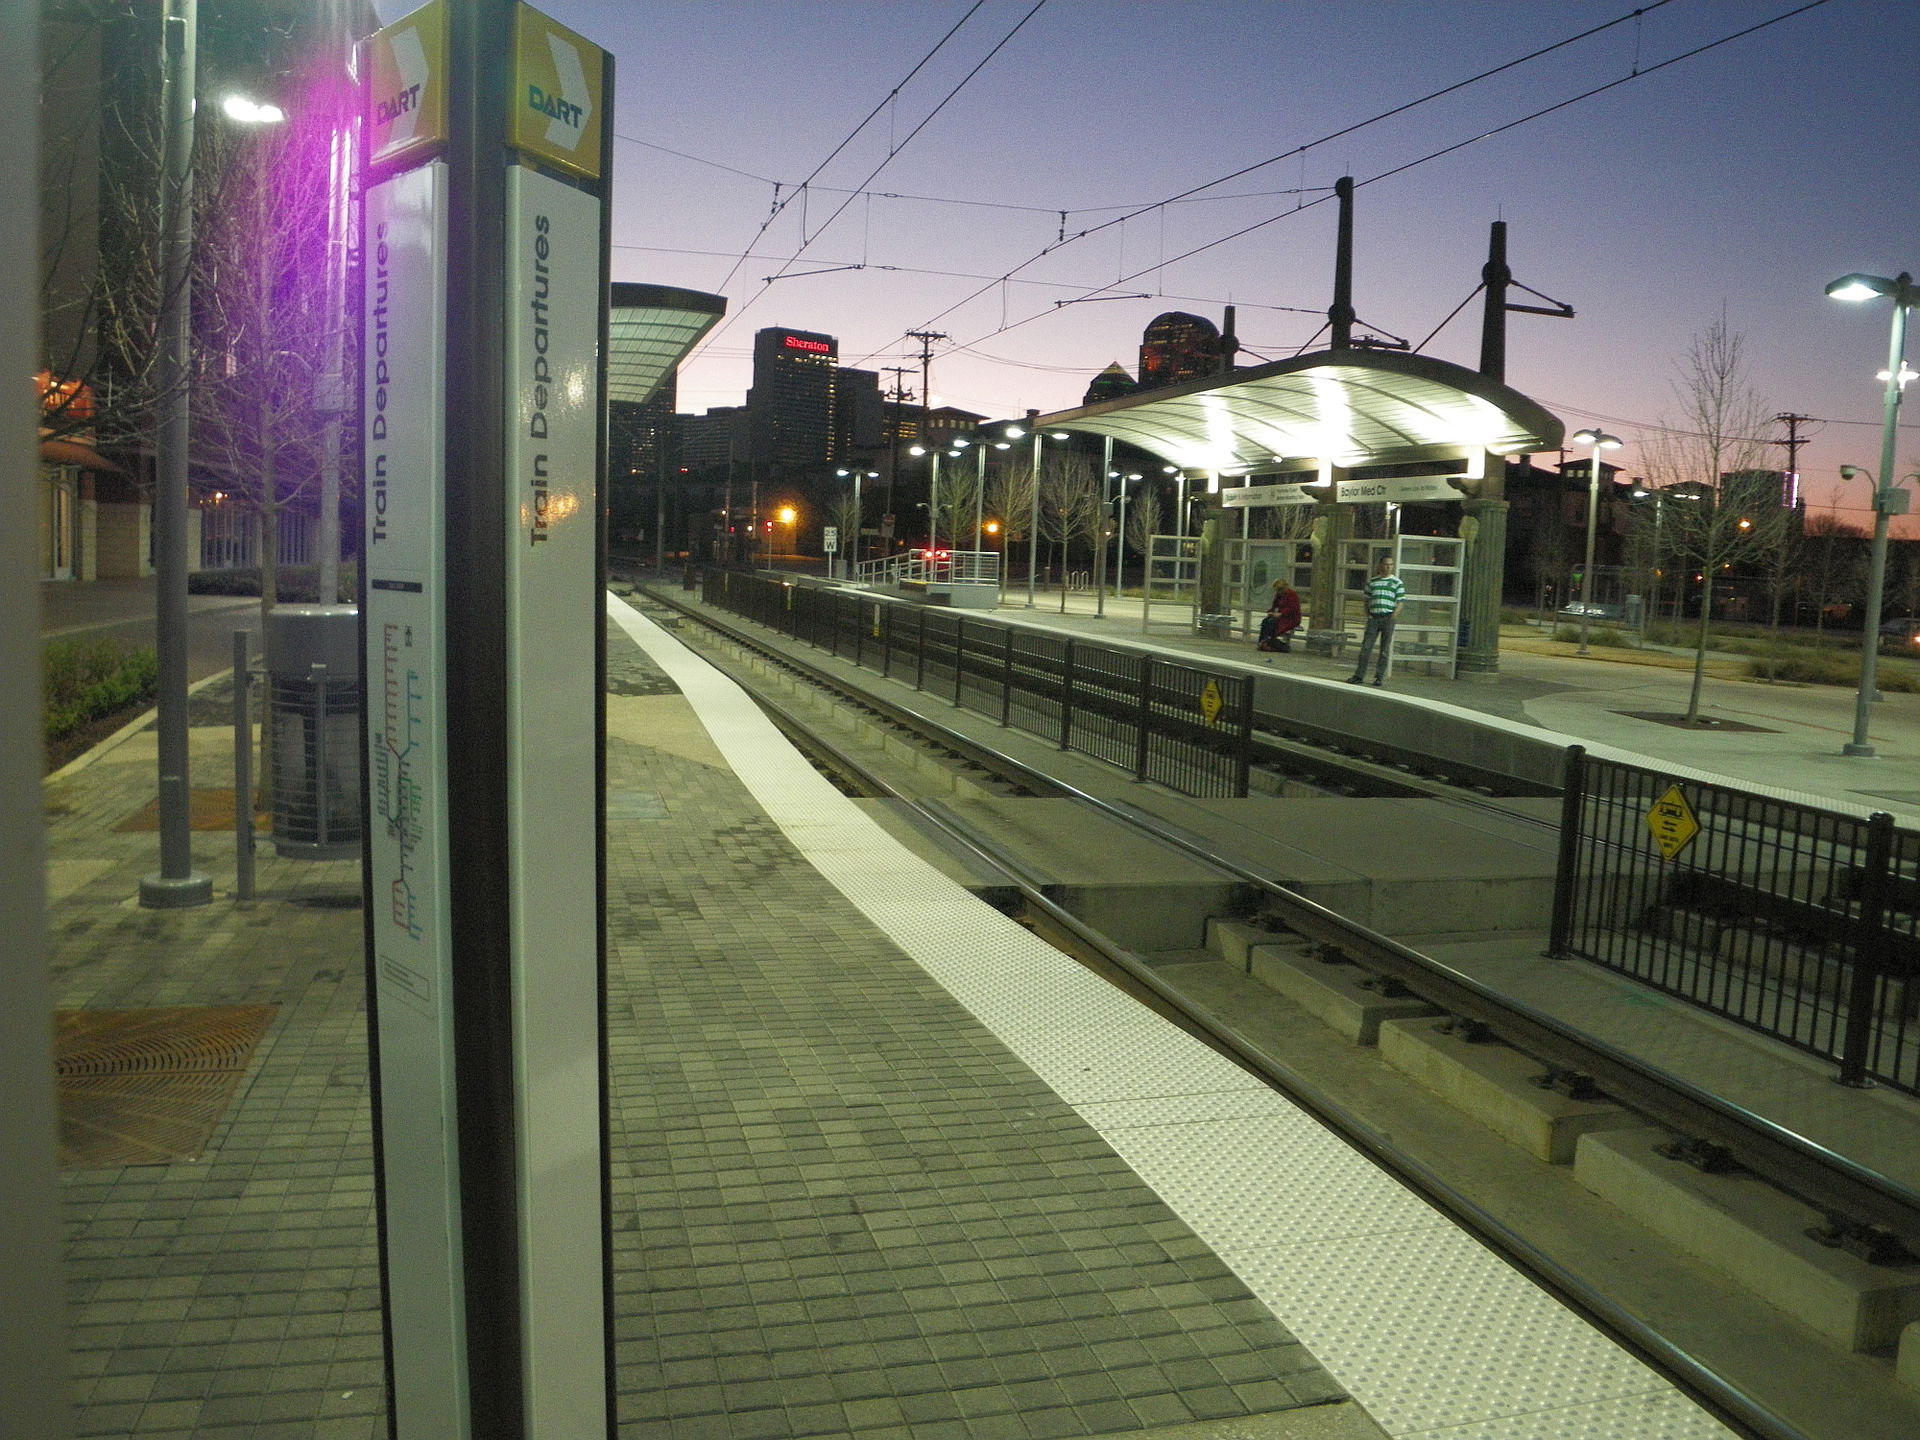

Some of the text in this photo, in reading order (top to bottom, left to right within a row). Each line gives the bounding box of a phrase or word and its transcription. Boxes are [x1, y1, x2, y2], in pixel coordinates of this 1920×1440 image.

[377, 83, 421, 126] DART
[528, 84, 582, 129] DART
[785, 336, 829, 352] Sheraton
[372, 223, 390, 545] Train Departures
[531, 215, 552, 547] Train Departures
[1341, 487, 1360, 498] Baylor
[1361, 486, 1376, 496] Med
[826, 541, 836, 549] W
